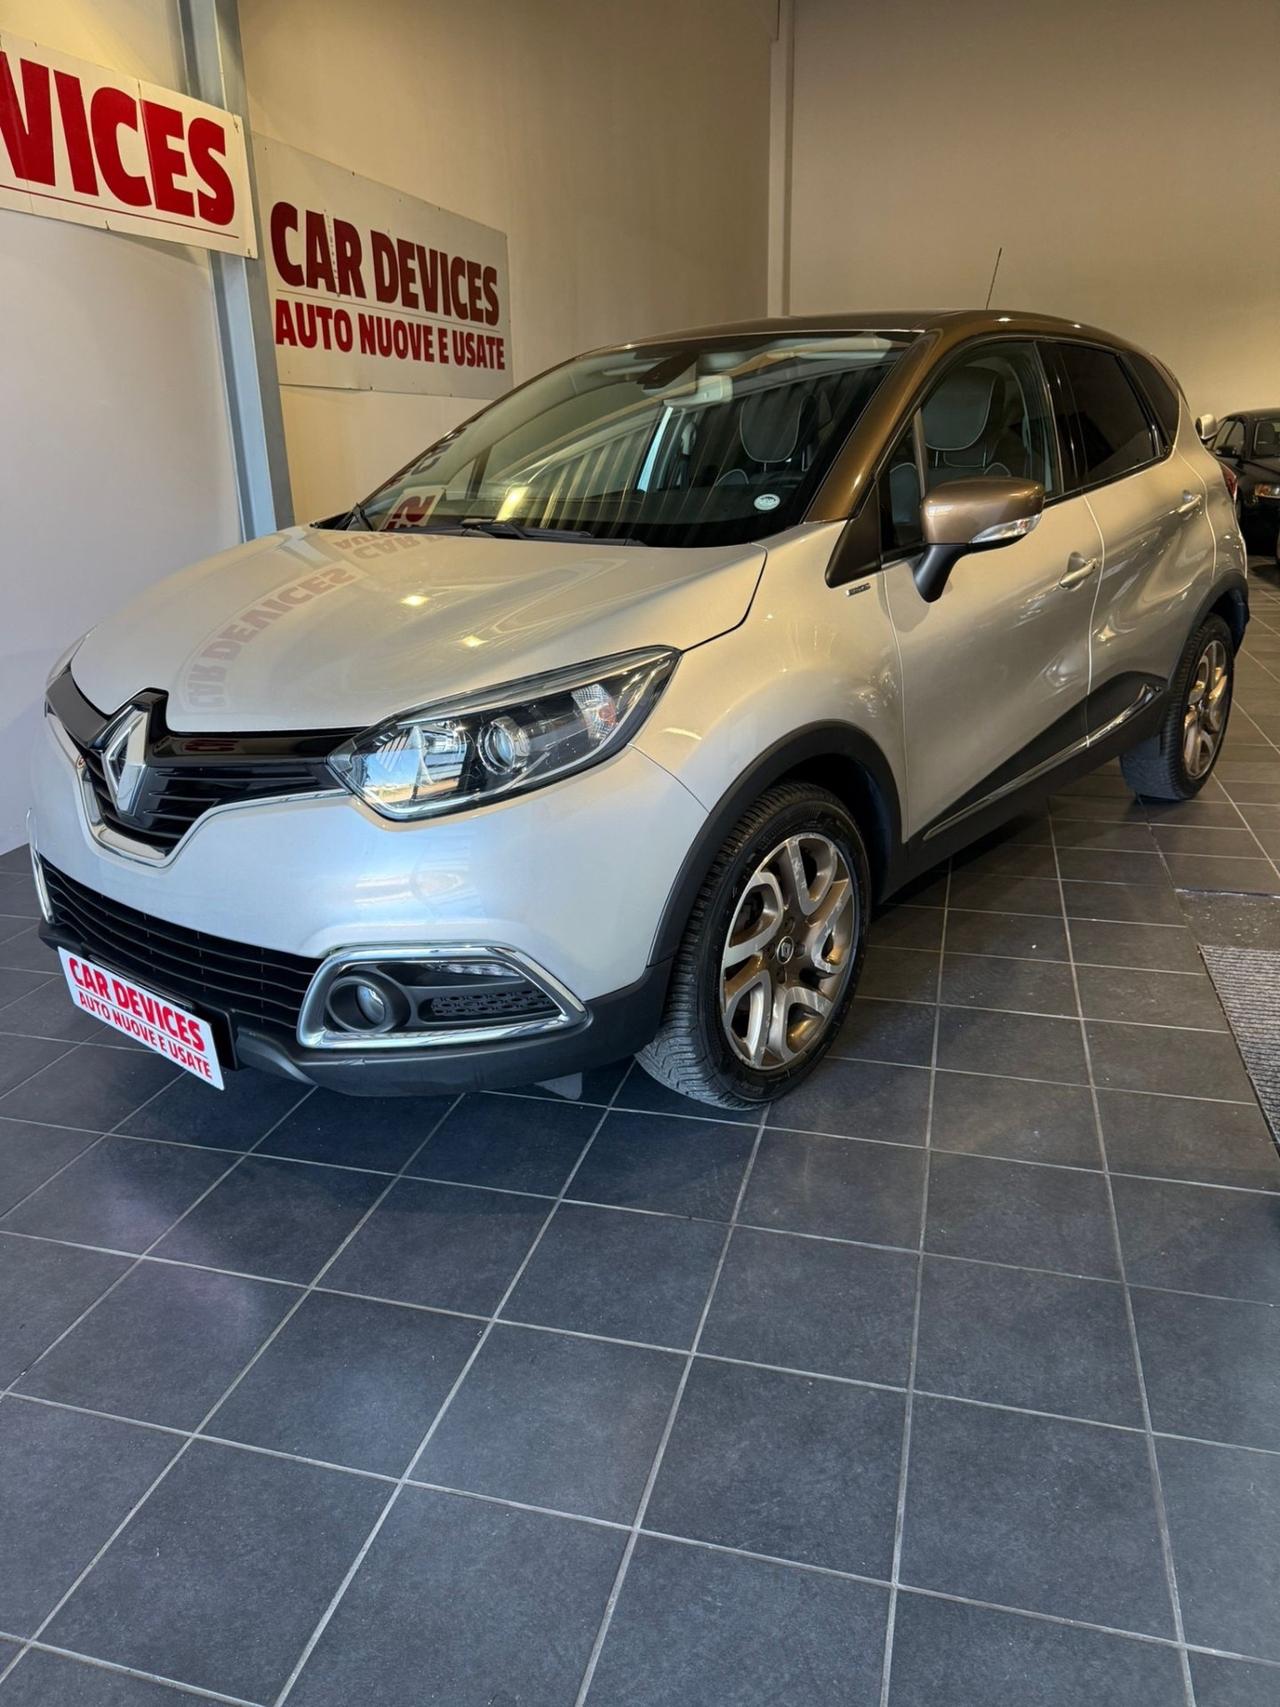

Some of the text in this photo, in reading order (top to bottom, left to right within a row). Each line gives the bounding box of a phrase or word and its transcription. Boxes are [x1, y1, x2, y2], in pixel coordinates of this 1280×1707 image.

[270, 201, 499, 326] CAR DEVICES
[275, 298, 506, 371] AUTO NUOVE E USATE
[68, 957, 205, 1053] CAR DEVICES
[78, 991, 213, 1079] AUTO NUOVE E USATE
